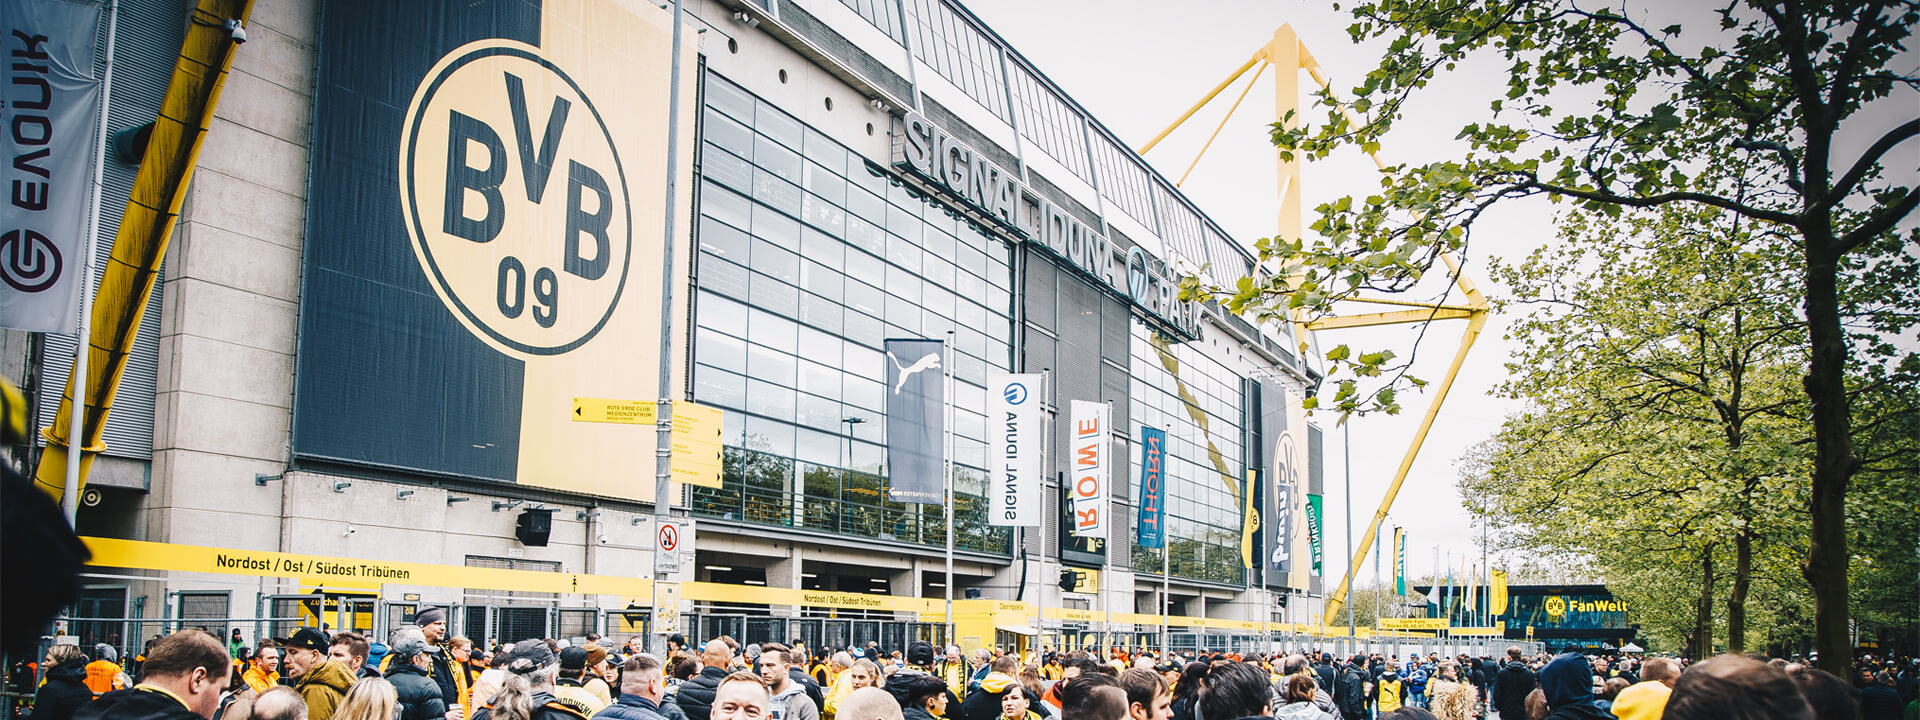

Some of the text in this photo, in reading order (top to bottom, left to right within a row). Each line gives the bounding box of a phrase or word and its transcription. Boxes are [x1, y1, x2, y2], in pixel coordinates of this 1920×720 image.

[443, 70, 613, 281] BVB
[903, 111, 1033, 238] SIGNAL
[1038, 197, 1116, 289] IDUNA
[496, 255, 559, 329] 09
[216, 554, 410, 580] Nordost / Ost / Südost Tribünen
[804, 594, 826, 604] Nordost
[830, 596, 839, 605] Ost
[842, 596, 860, 607] Südost
[860, 597, 882, 608] Tribünen
[1548, 599, 1628, 612] BVB FanWelt
